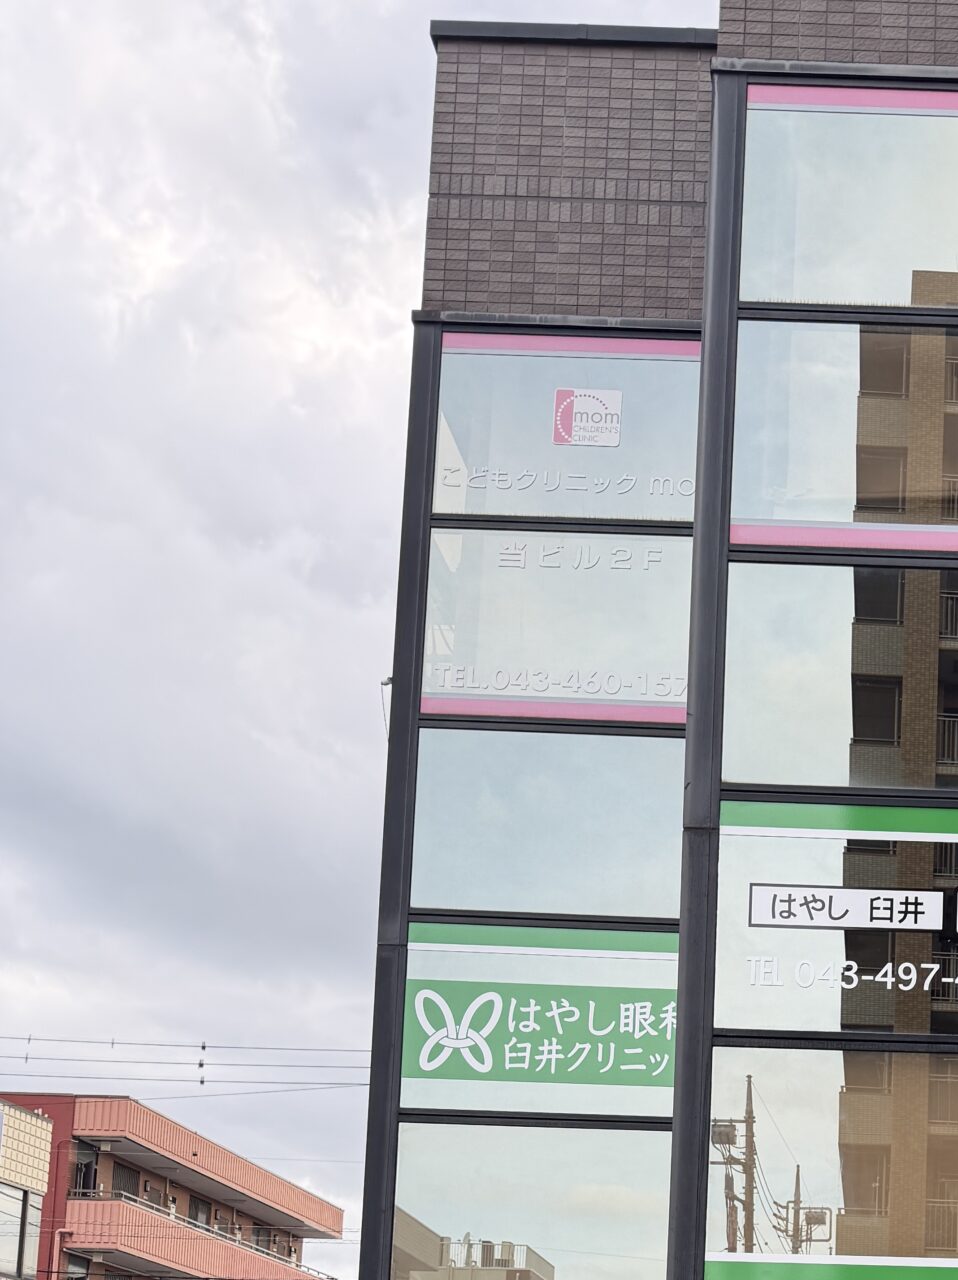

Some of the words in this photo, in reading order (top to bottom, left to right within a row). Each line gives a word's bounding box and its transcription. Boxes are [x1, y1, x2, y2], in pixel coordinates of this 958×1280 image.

[574, 411, 620, 425] mom
[572, 434, 600, 443] CLINIC
[573, 425, 619, 434] CHILDREN'S
[441, 466, 638, 496] こどもクリニック
[770, 893, 850, 921] はやし
[868, 896, 925, 925] 臼井
[746, 956, 785, 987] TEL
